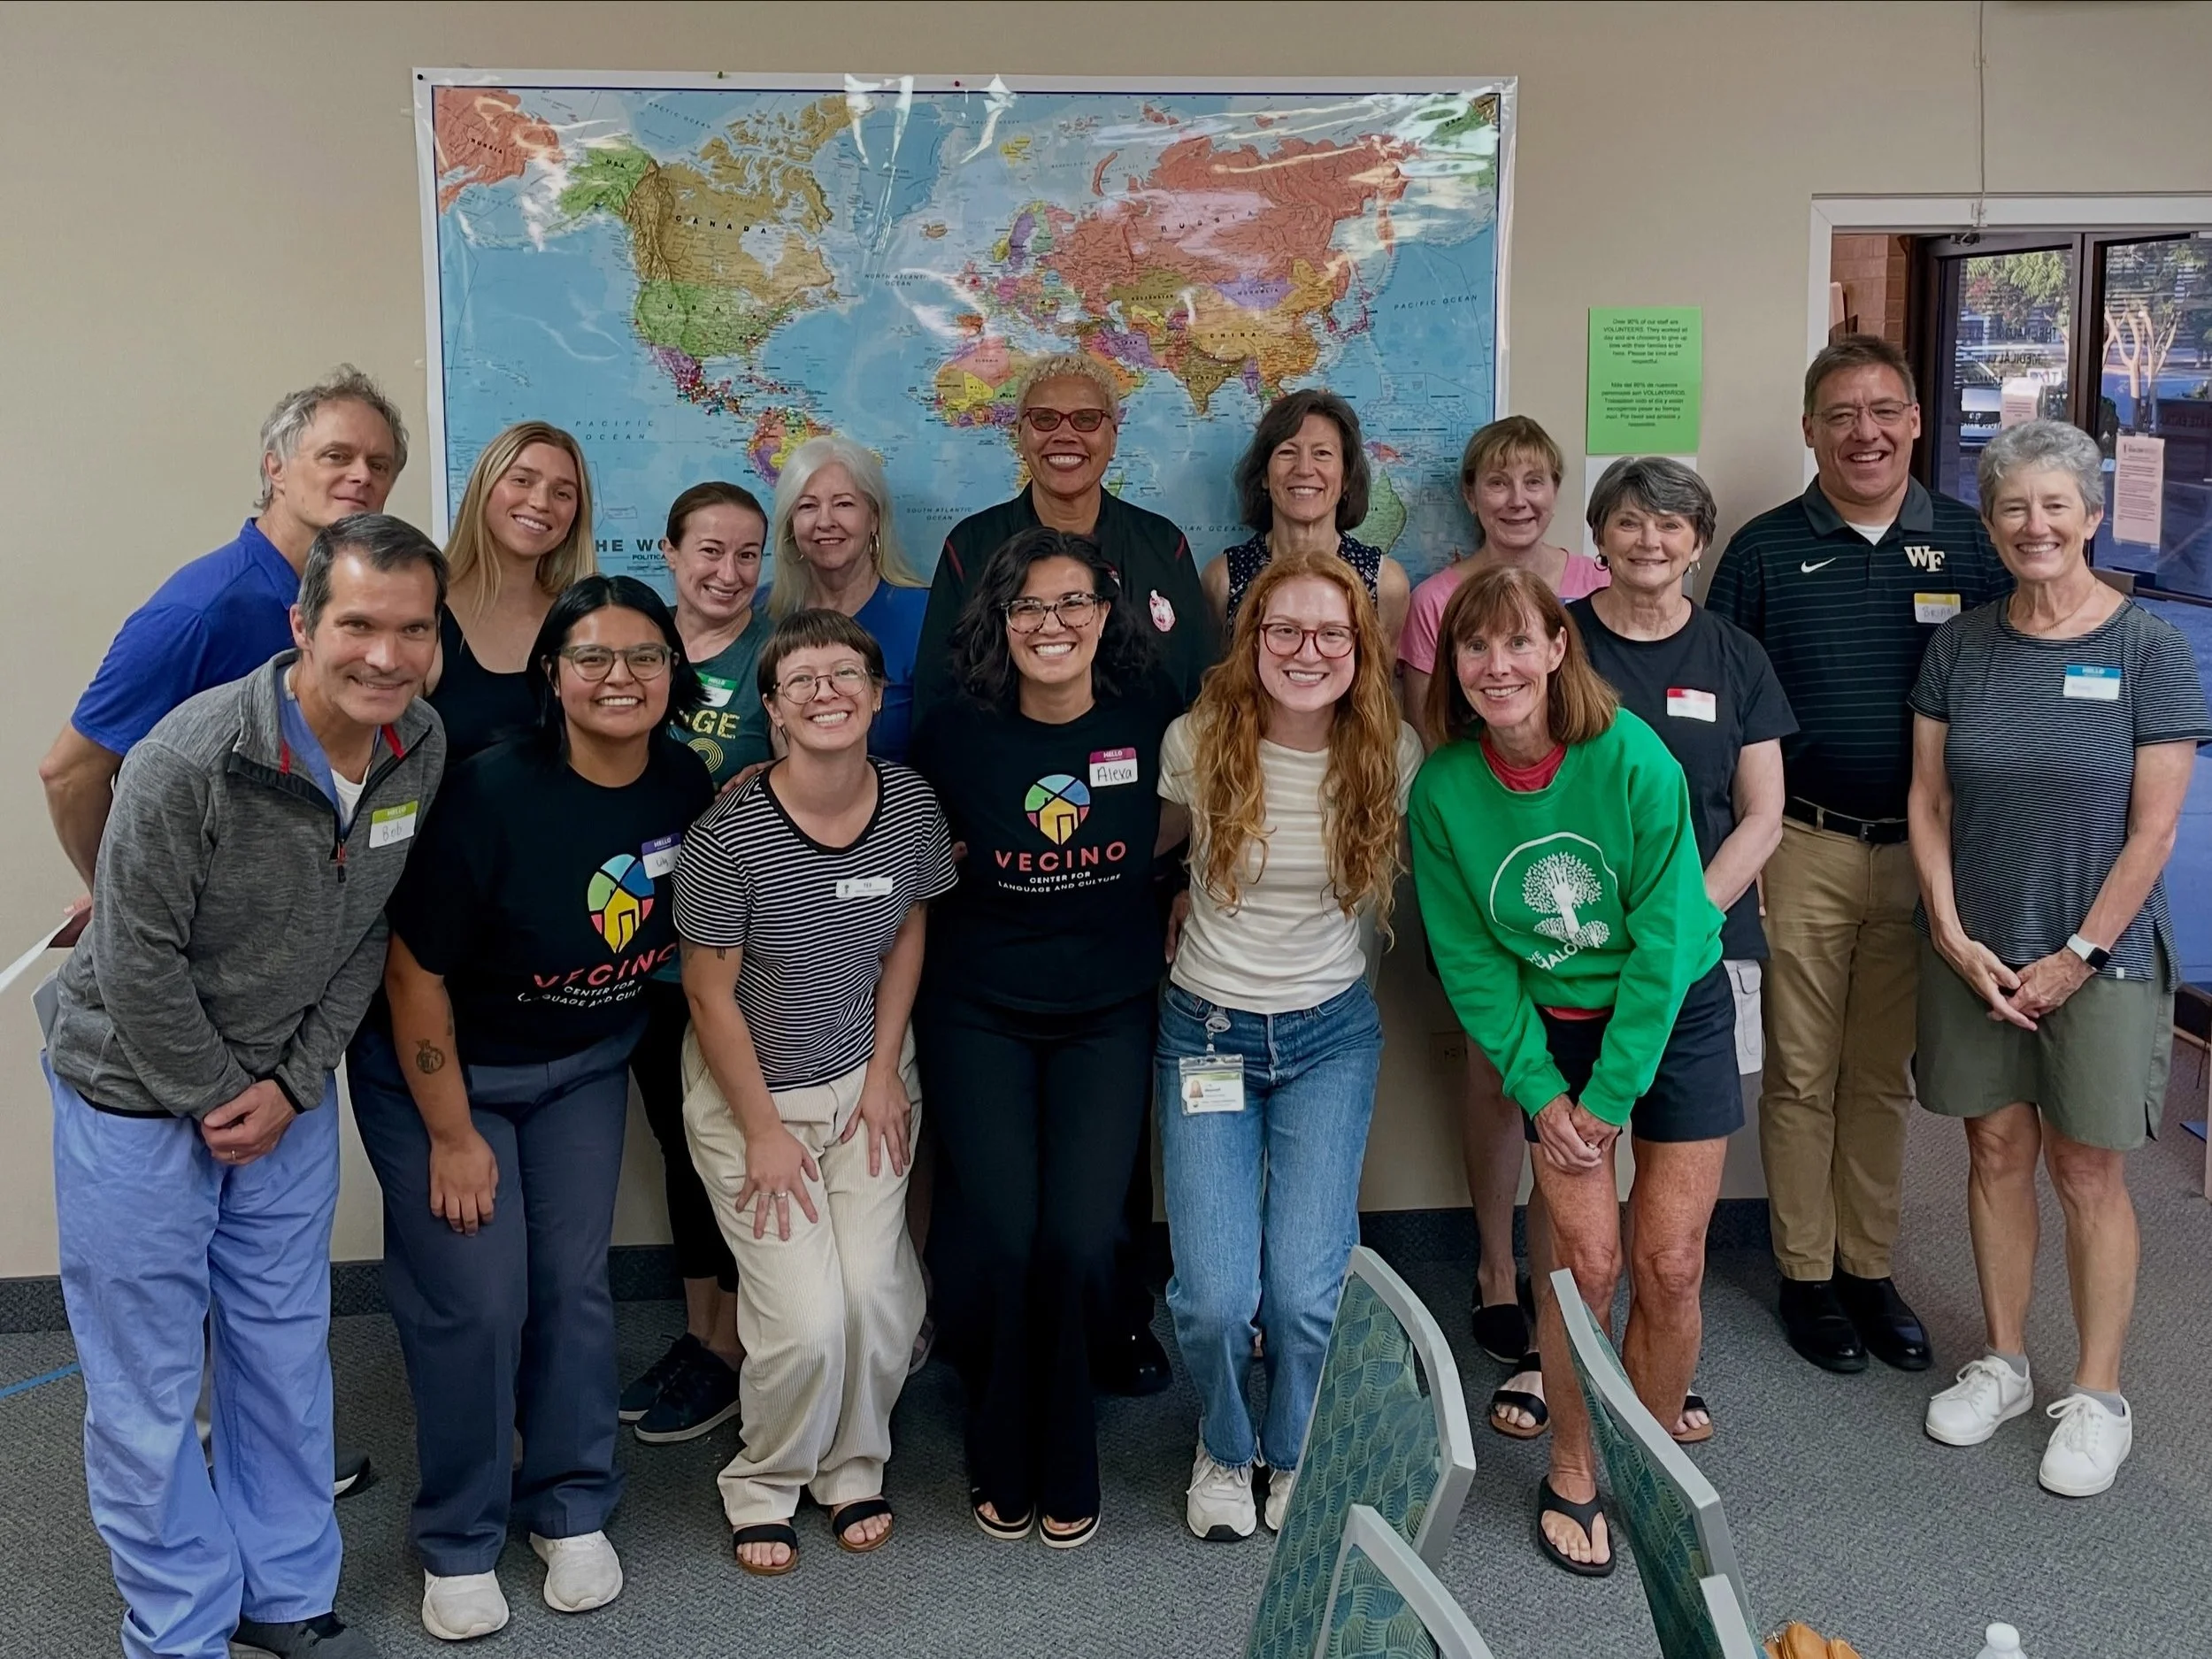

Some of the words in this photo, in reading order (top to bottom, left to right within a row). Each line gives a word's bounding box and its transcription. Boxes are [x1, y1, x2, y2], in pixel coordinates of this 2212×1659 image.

[675, 215, 767, 234] CANADA
[1161, 210, 1253, 234] RUSSIA
[1394, 299, 1437, 311] PACIFIC
[1442, 294, 1478, 305] OCEAN
[1903, 545, 1946, 572] WF
[1102, 749, 1123, 758] HELLO
[1096, 766, 1133, 782] Alexa
[387, 806, 406, 816] HELLO
[382, 821, 403, 841] Bob
[653, 836, 672, 848] HELLO
[995, 841, 1127, 872] VECINO
[997, 879, 1051, 894] LANGUAGE
[1054, 882, 1076, 892] AND
[1078, 872, 1122, 888] CULTURE
[1029, 874, 1068, 885] CENTER
[1071, 871, 1091, 880] FOR
[564, 985, 611, 997] CENTER
[612, 979, 635, 992] FOR
